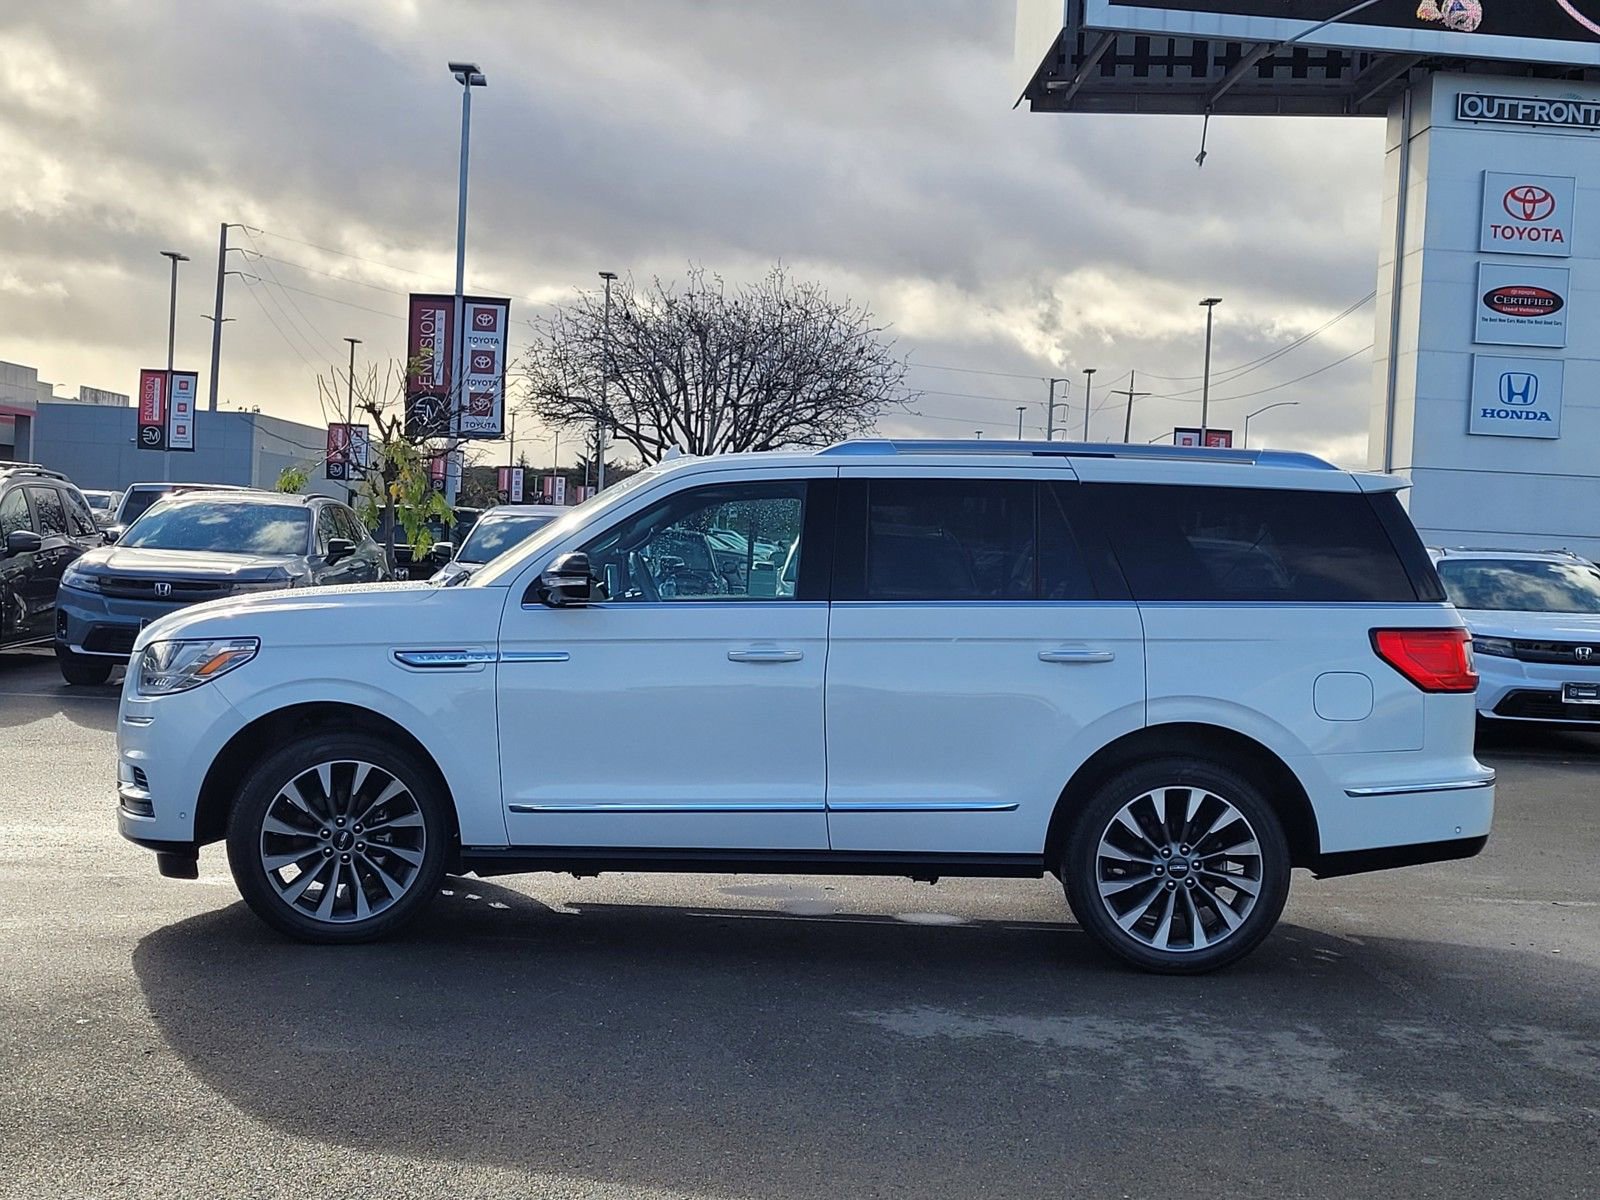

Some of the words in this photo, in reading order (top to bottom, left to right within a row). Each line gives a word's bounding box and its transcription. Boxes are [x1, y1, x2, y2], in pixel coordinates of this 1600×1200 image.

[1490, 224, 1565, 243] TOYOTA
[1493, 295, 1554, 306] CERTIFIED
[468, 336, 499, 345] TOYOTA
[418, 308, 435, 386] ENVSION
[467, 378, 498, 387] TOYOTA
[144, 376, 154, 421] ENVISION
[1480, 408, 1552, 421] HONDA
[465, 421, 497, 429] TOYOTA
